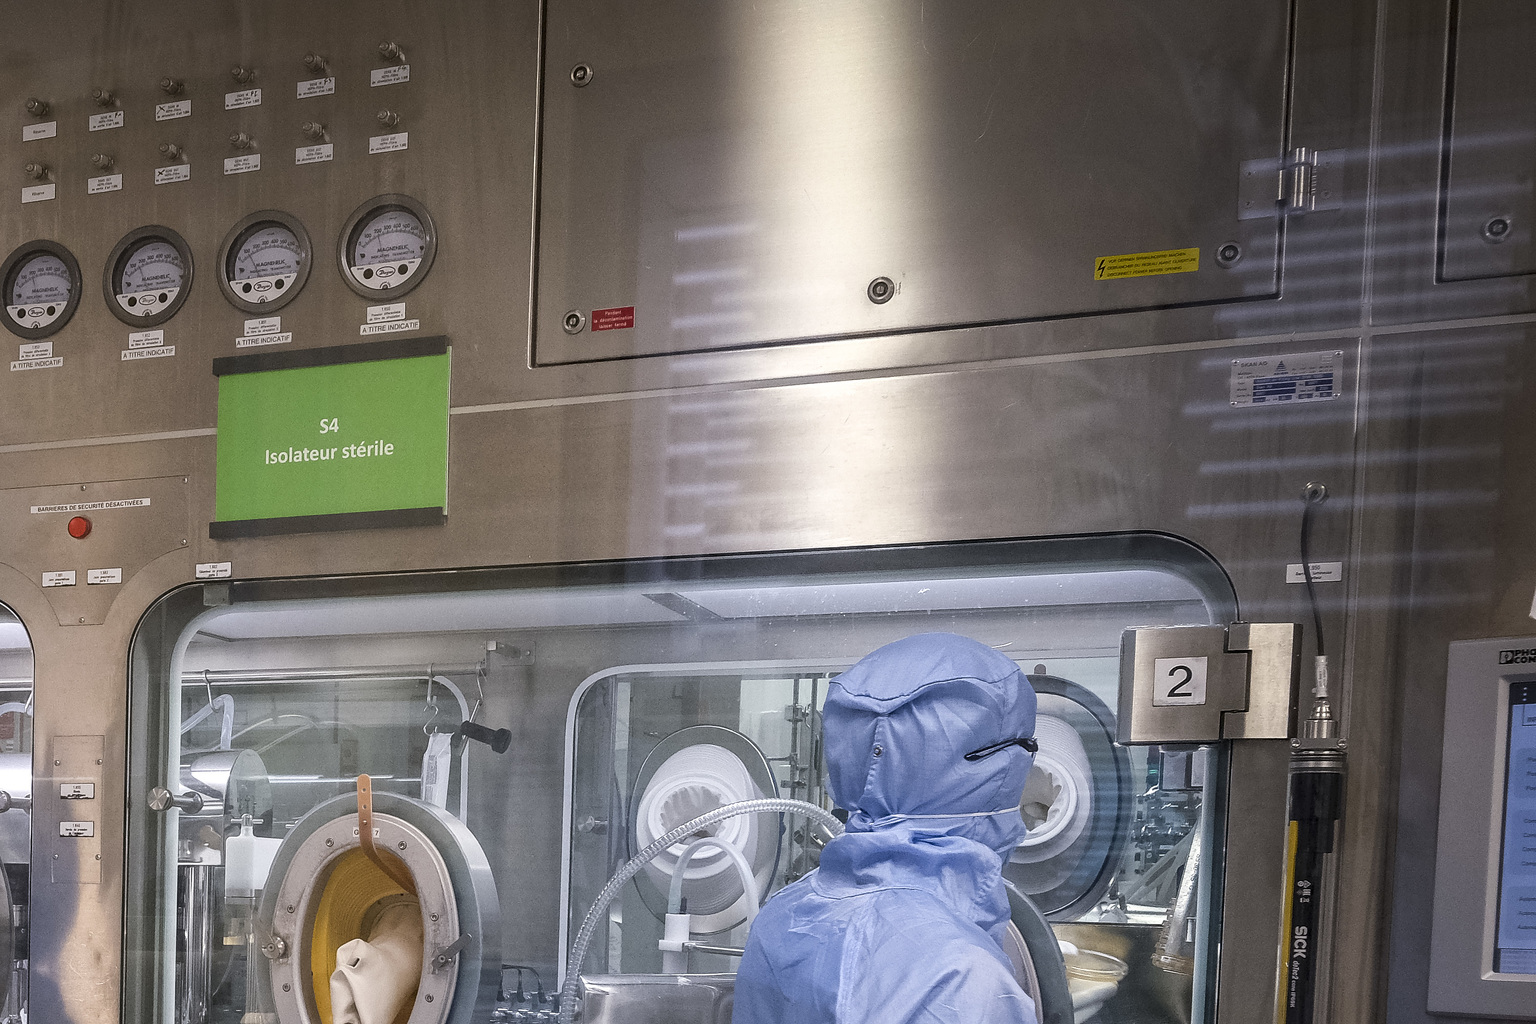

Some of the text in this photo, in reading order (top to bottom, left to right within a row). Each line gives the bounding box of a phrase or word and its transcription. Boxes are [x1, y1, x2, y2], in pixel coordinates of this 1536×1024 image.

[369, 324, 386, 332] TITRE
[388, 322, 418, 330] INDICATIF
[261, 335, 290, 344] INDICATIF
[146, 348, 174, 356] INDICATIF
[35, 359, 61, 367] INDICATIF
[319, 417, 339, 434] S4
[265, 440, 394, 464] Isolateur stérile
[1167, 665, 1193, 697] 2
[1293, 926, 1308, 959] SICK
